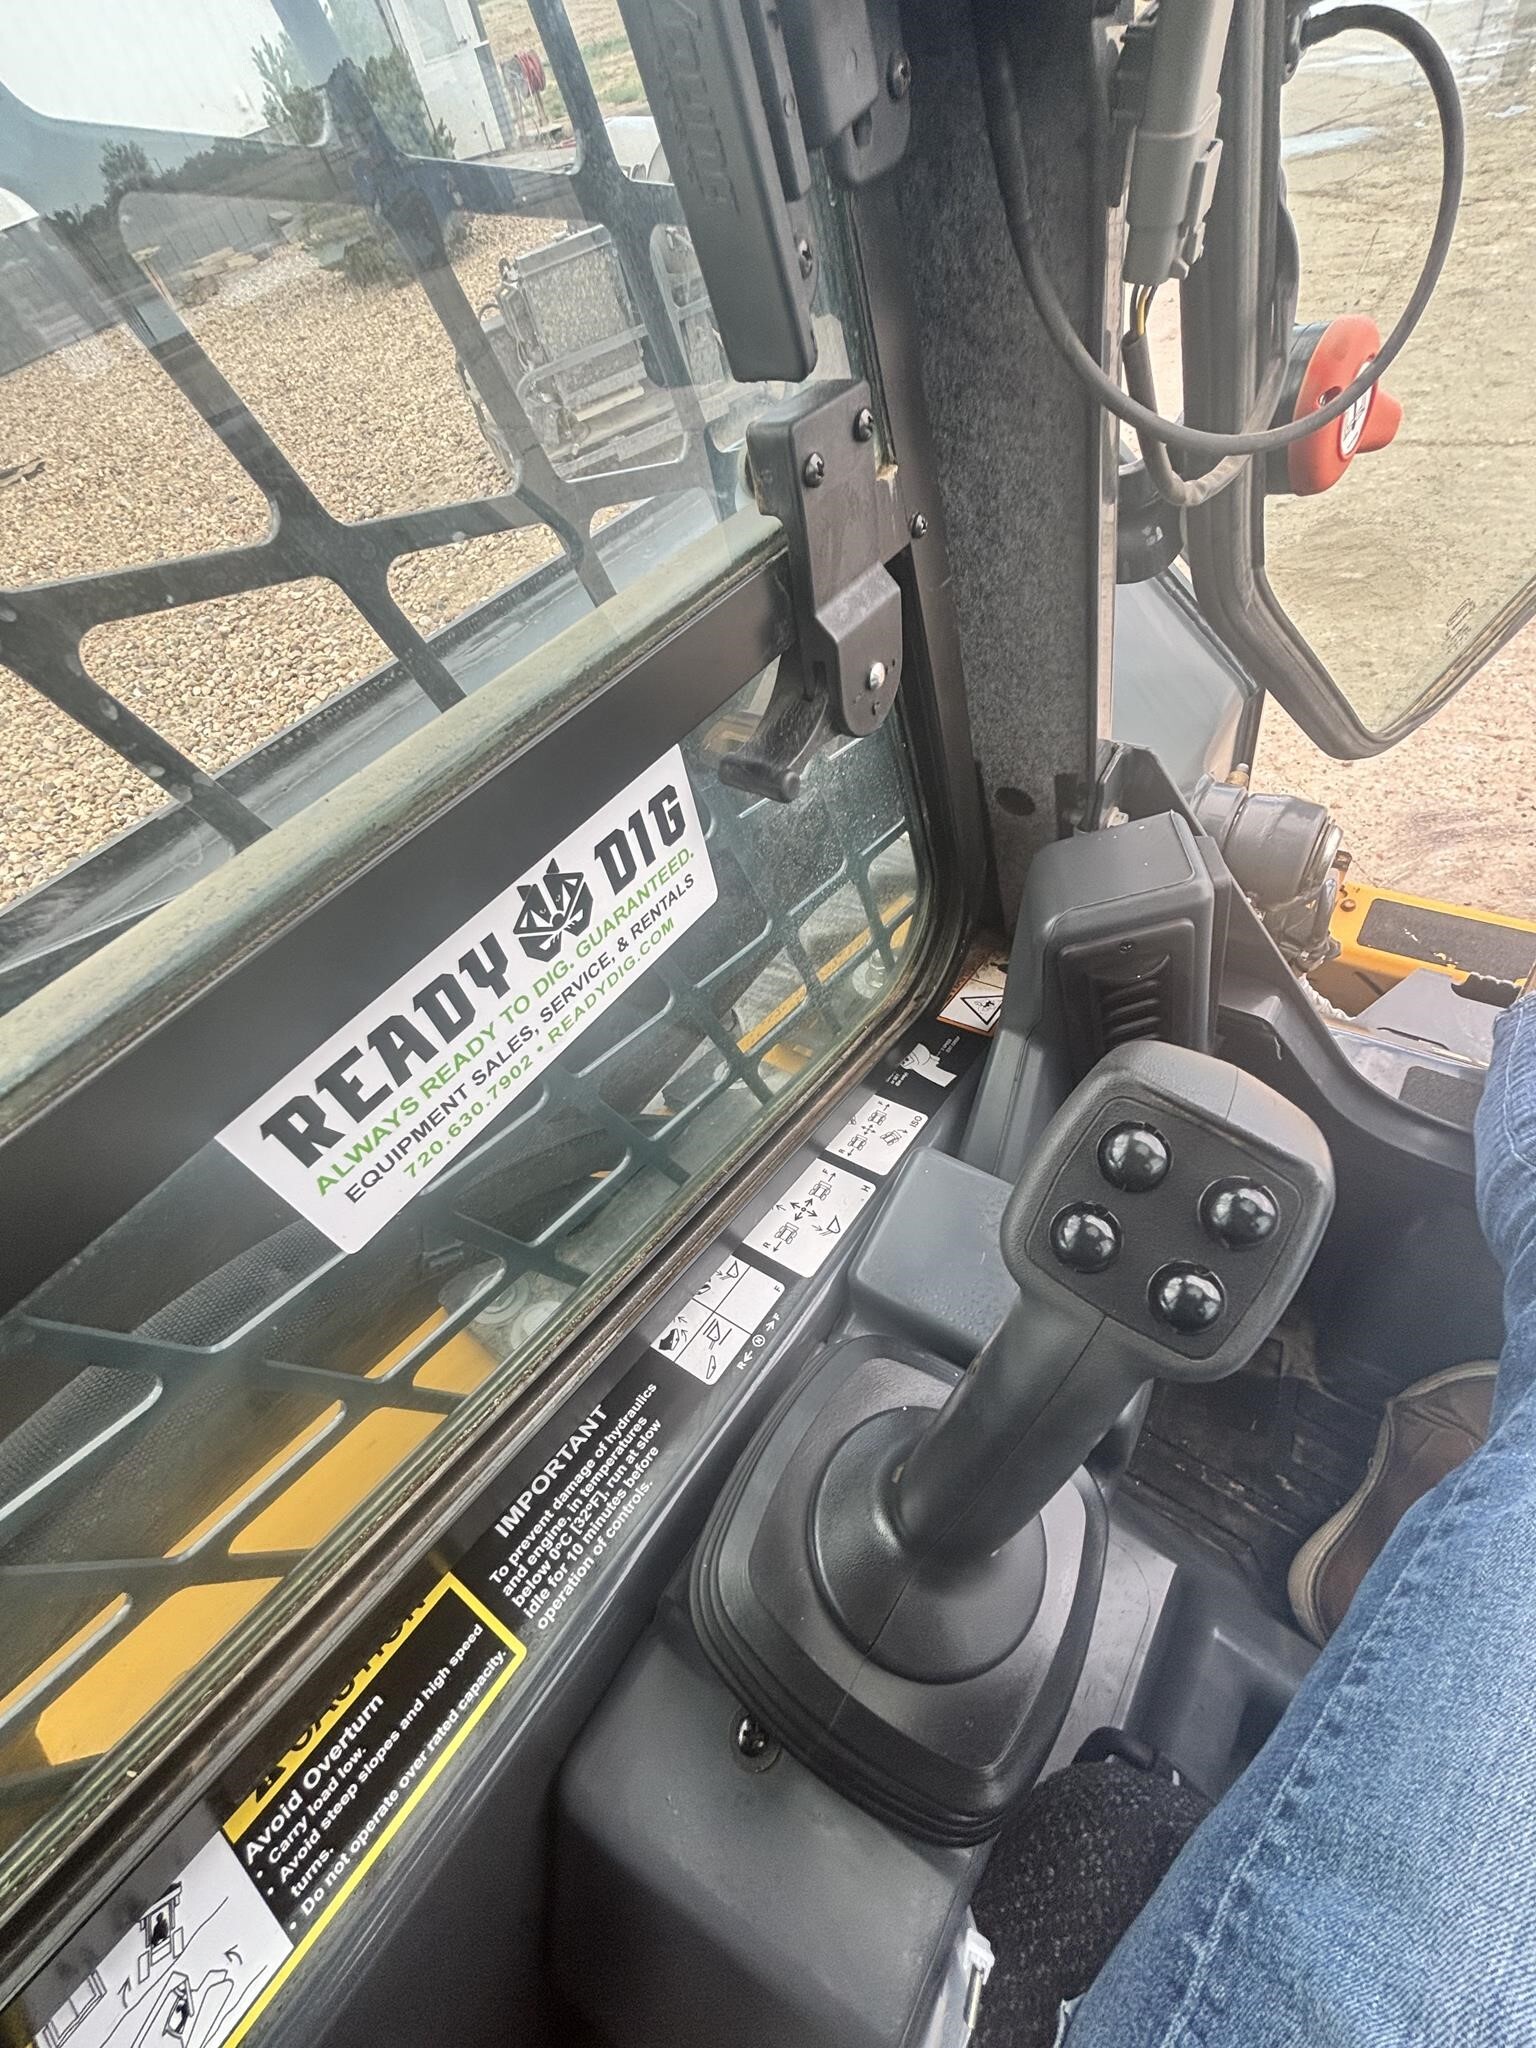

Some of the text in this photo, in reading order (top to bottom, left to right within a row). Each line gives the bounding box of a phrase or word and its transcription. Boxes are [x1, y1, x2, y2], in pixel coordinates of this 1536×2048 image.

[260, 784, 687, 1168] READY DIG
[316, 848, 696, 1197] ALWAYS READY TO DIG. GUARANTEED.
[344, 873, 696, 1204] EQUIPMENT SALES, SERVICE, & RENTALS
[402, 917, 676, 1179] 720.630.7902 READYDIG.COM
[909, 1115, 922, 1128] ISO
[736, 1361, 747, 1370] R
[488, 1382, 657, 1585] To prevent damage of hydraulics
[494, 1404, 608, 1538] IMPORTANT
[502, 1415, 648, 1597] and engine, in temperatures
[511, 1562, 551, 1608] below
[606, 1464, 628, 1488] run
[625, 1449, 640, 1466] at
[637, 1418, 662, 1451] slow
[523, 1445, 659, 1619] idle for 10 minutes before
[537, 1480, 653, 1630] operation of controls.
[244, 1695, 384, 1864] Avoid Overturn
[267, 1746, 367, 1866] Carry load low.
[277, 1623, 484, 1885] Avoid steep slopes and high speed
[300, 1650, 508, 1917] Do not operate over rated capacity.
[290, 1847, 334, 1898] turns.
